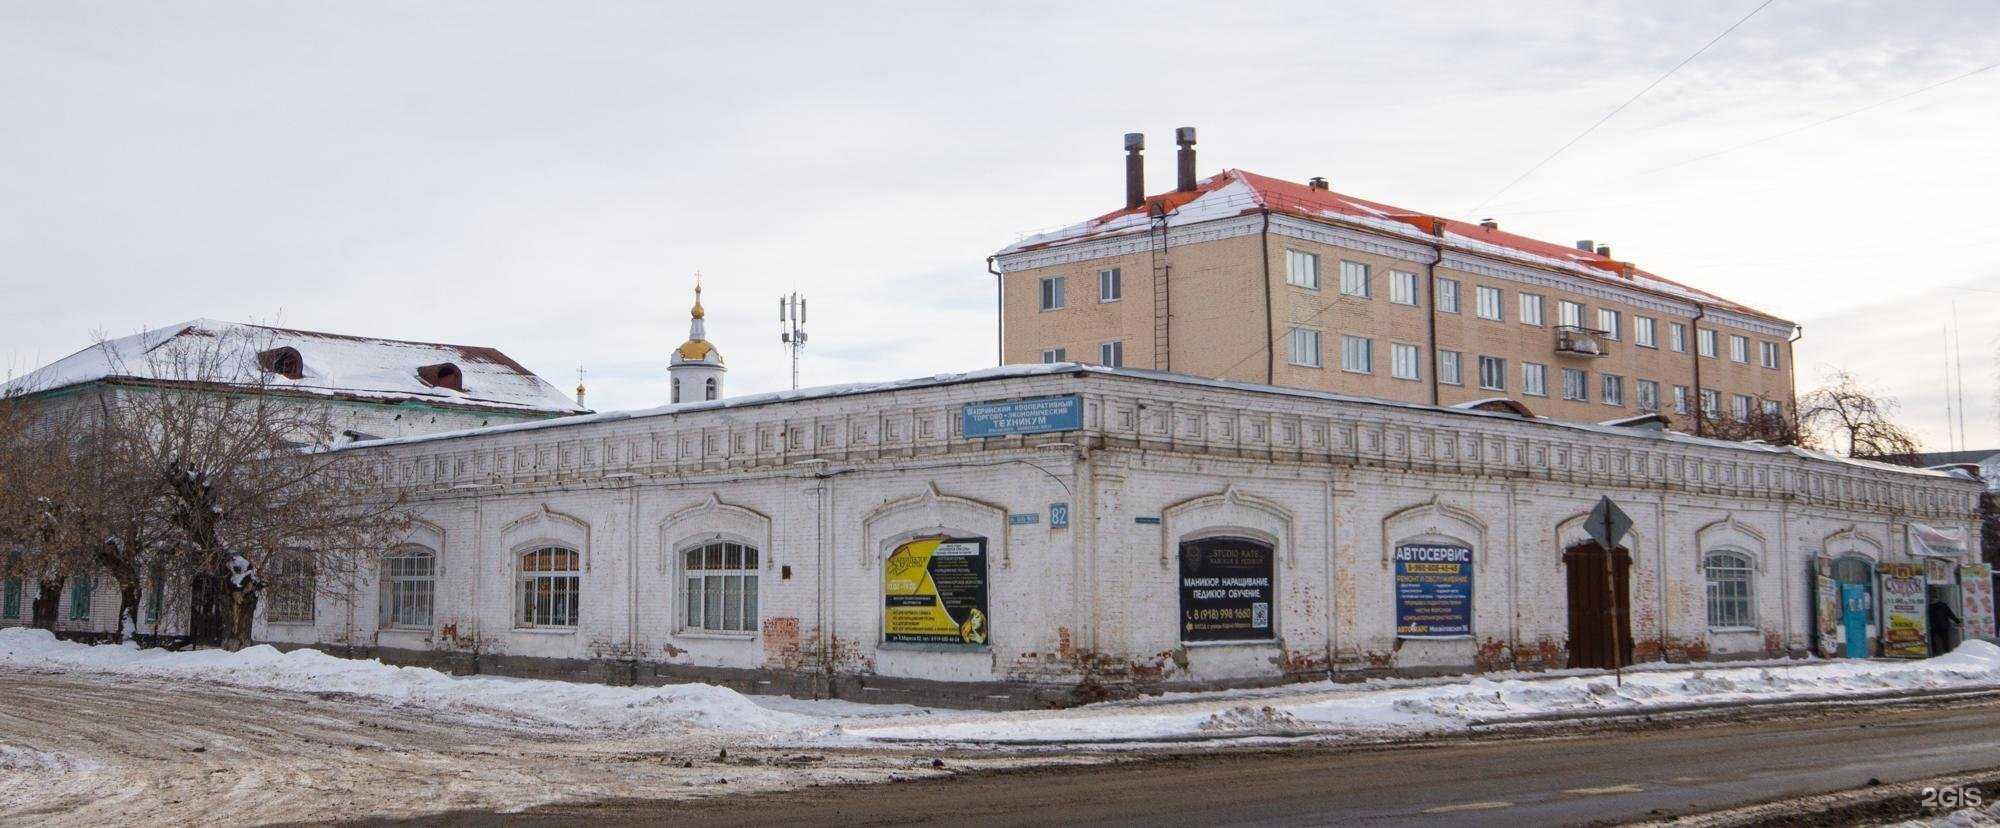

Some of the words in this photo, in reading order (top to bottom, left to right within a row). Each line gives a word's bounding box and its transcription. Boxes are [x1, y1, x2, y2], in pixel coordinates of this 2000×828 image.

[1014, 399, 1073, 410] КООПЕРАТИВНЫЙ
[993, 416, 1047, 428] ТЕХНИКУМ
[1052, 507, 1067, 525] 82
[1396, 547, 1469, 561] АВТОСЕРВИС
[1193, 608, 1200, 620] 8
